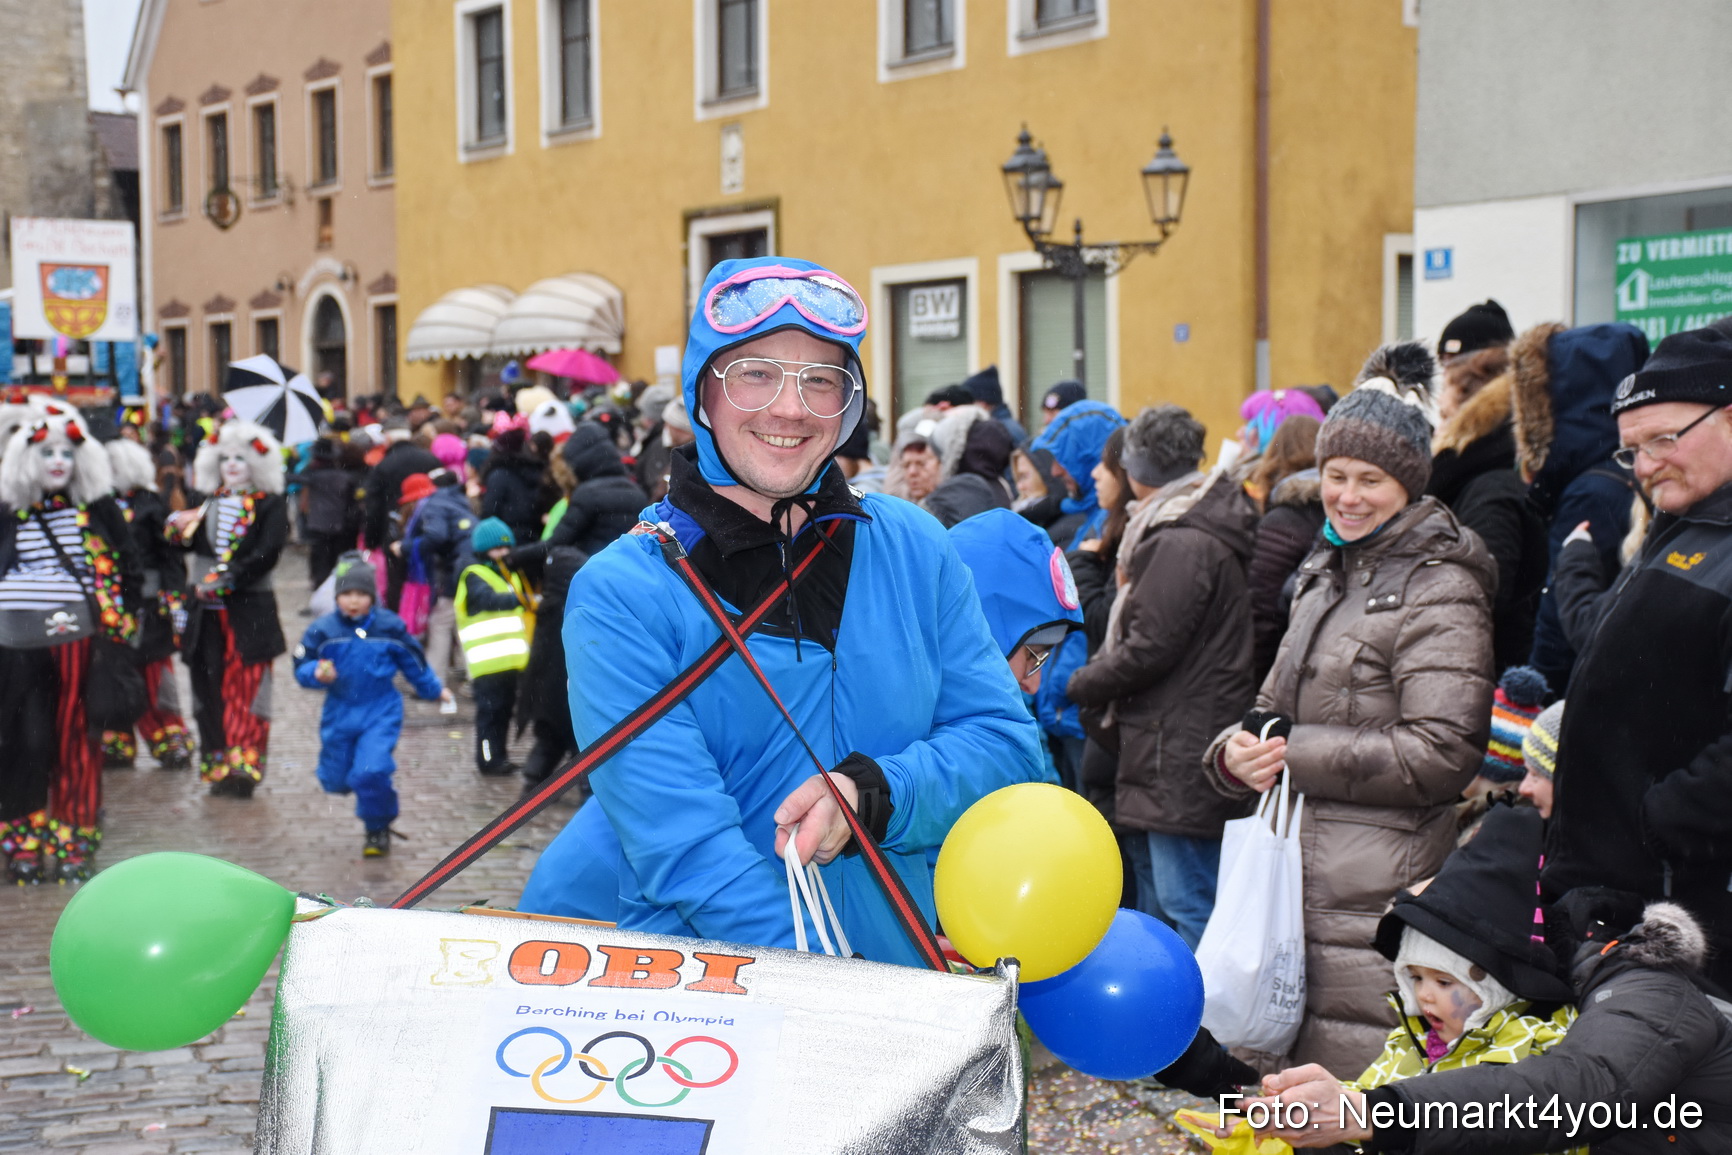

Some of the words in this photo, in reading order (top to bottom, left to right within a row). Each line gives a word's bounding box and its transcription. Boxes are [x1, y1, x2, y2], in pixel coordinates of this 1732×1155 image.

[1618, 242, 1642, 265] ZU
[914, 291, 956, 316] BW
[508, 939, 756, 995] OBI
[515, 1005, 608, 1021] Berching
[614, 1009, 645, 1021] bei
[653, 1010, 735, 1027] Olympia
